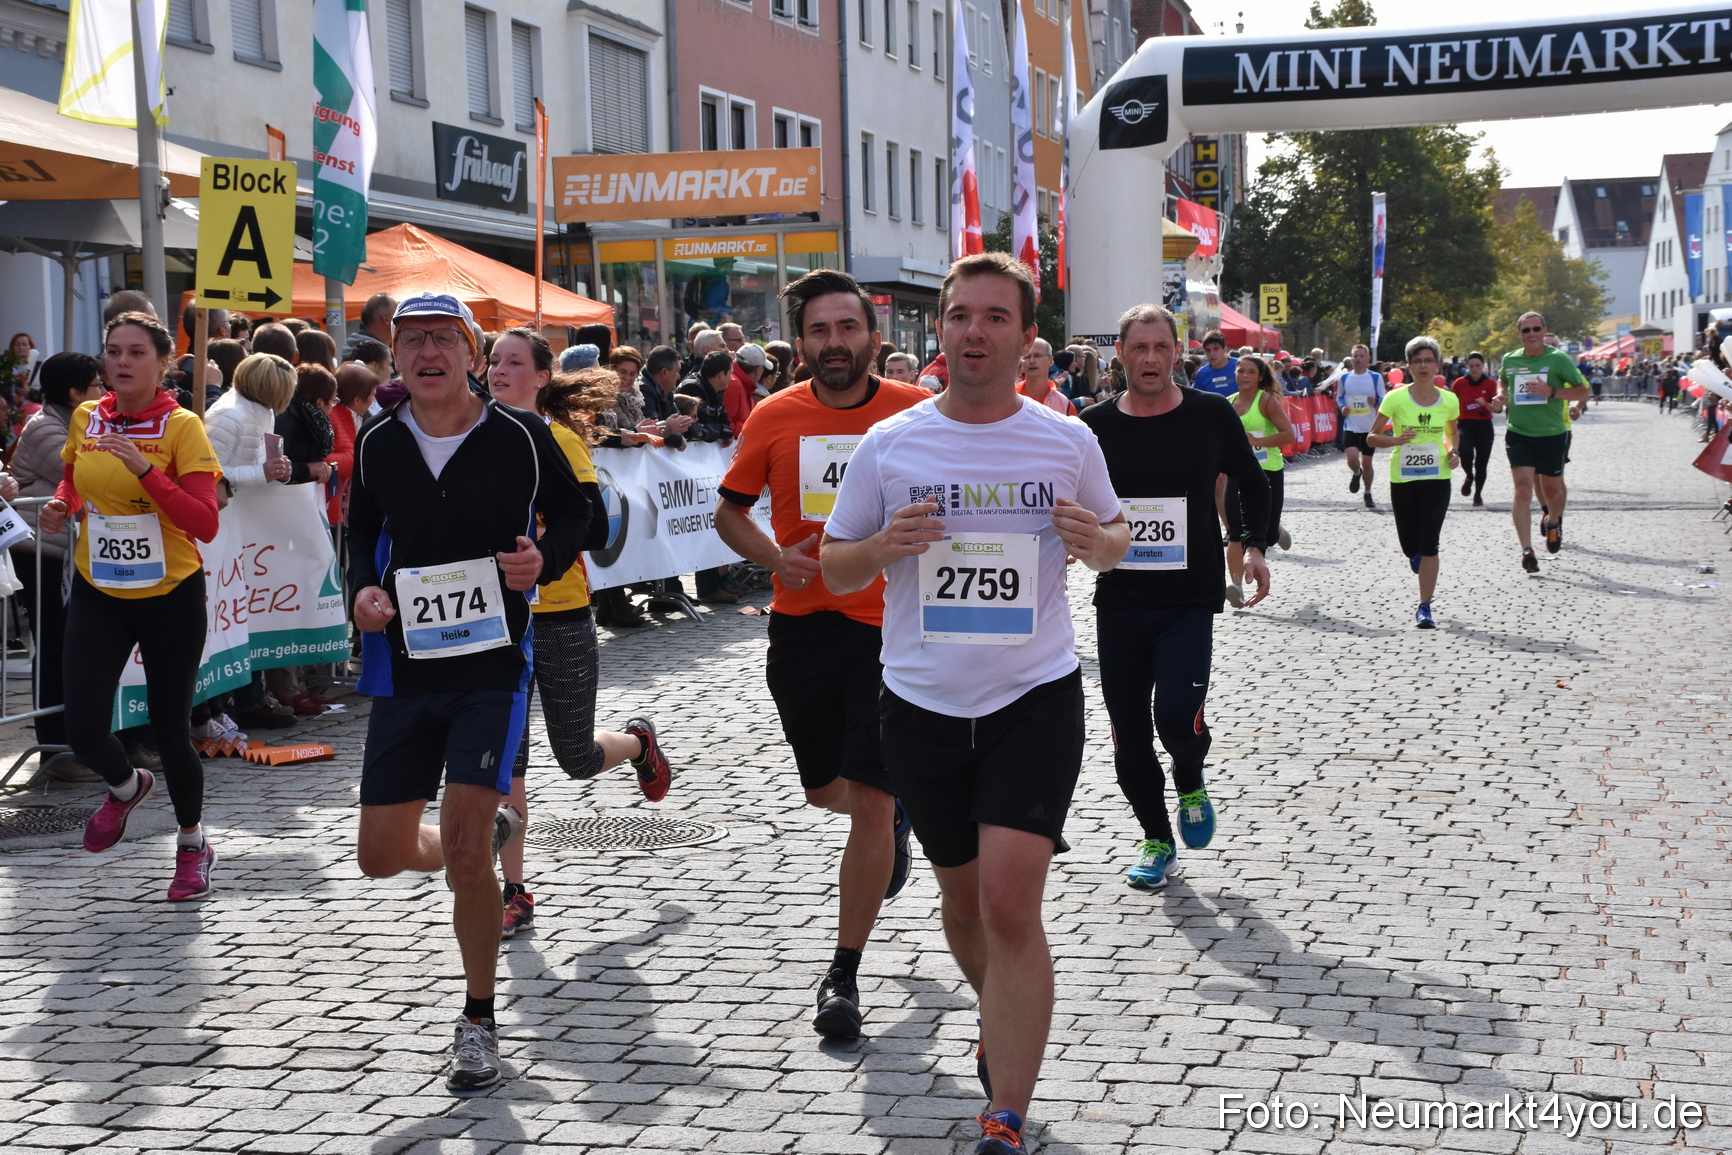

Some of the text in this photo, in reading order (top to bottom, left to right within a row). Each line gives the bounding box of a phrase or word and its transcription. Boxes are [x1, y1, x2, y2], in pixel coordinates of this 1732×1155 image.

[1233, 46, 1368, 94] MINI
[1124, 108, 1142, 116] MINI
[212, 163, 287, 195] Block
[563, 166, 809, 206] RUNMARKT.DE
[216, 205, 273, 280] A
[673, 240, 768, 256] RUNMARKT.DE
[1262, 285, 1284, 294] Block
[1266, 296, 1281, 316] B
[1444, 338, 1453, 350] C
[1352, 401, 1366, 409] 176
[1405, 454, 1434, 466] 2256
[658, 478, 694, 510] BMW
[963, 481, 1055, 508] NXTGN
[951, 509, 974, 517] DIGITAL
[975, 508, 1031, 516] TRANSFORMATION
[1137, 504, 1164, 512] BOCK
[110, 522, 137, 531] BOCK
[665, 515, 703, 537] WENIGER
[97, 537, 151, 561] 2635
[963, 543, 1004, 553] BOCK
[1133, 549, 1163, 558] Karsten
[114, 567, 135, 577] Luisa
[431, 569, 467, 583] BOCK
[936, 566, 1020, 601] 2759
[412, 586, 488, 624] 2174
[440, 629, 471, 641] Heiko
